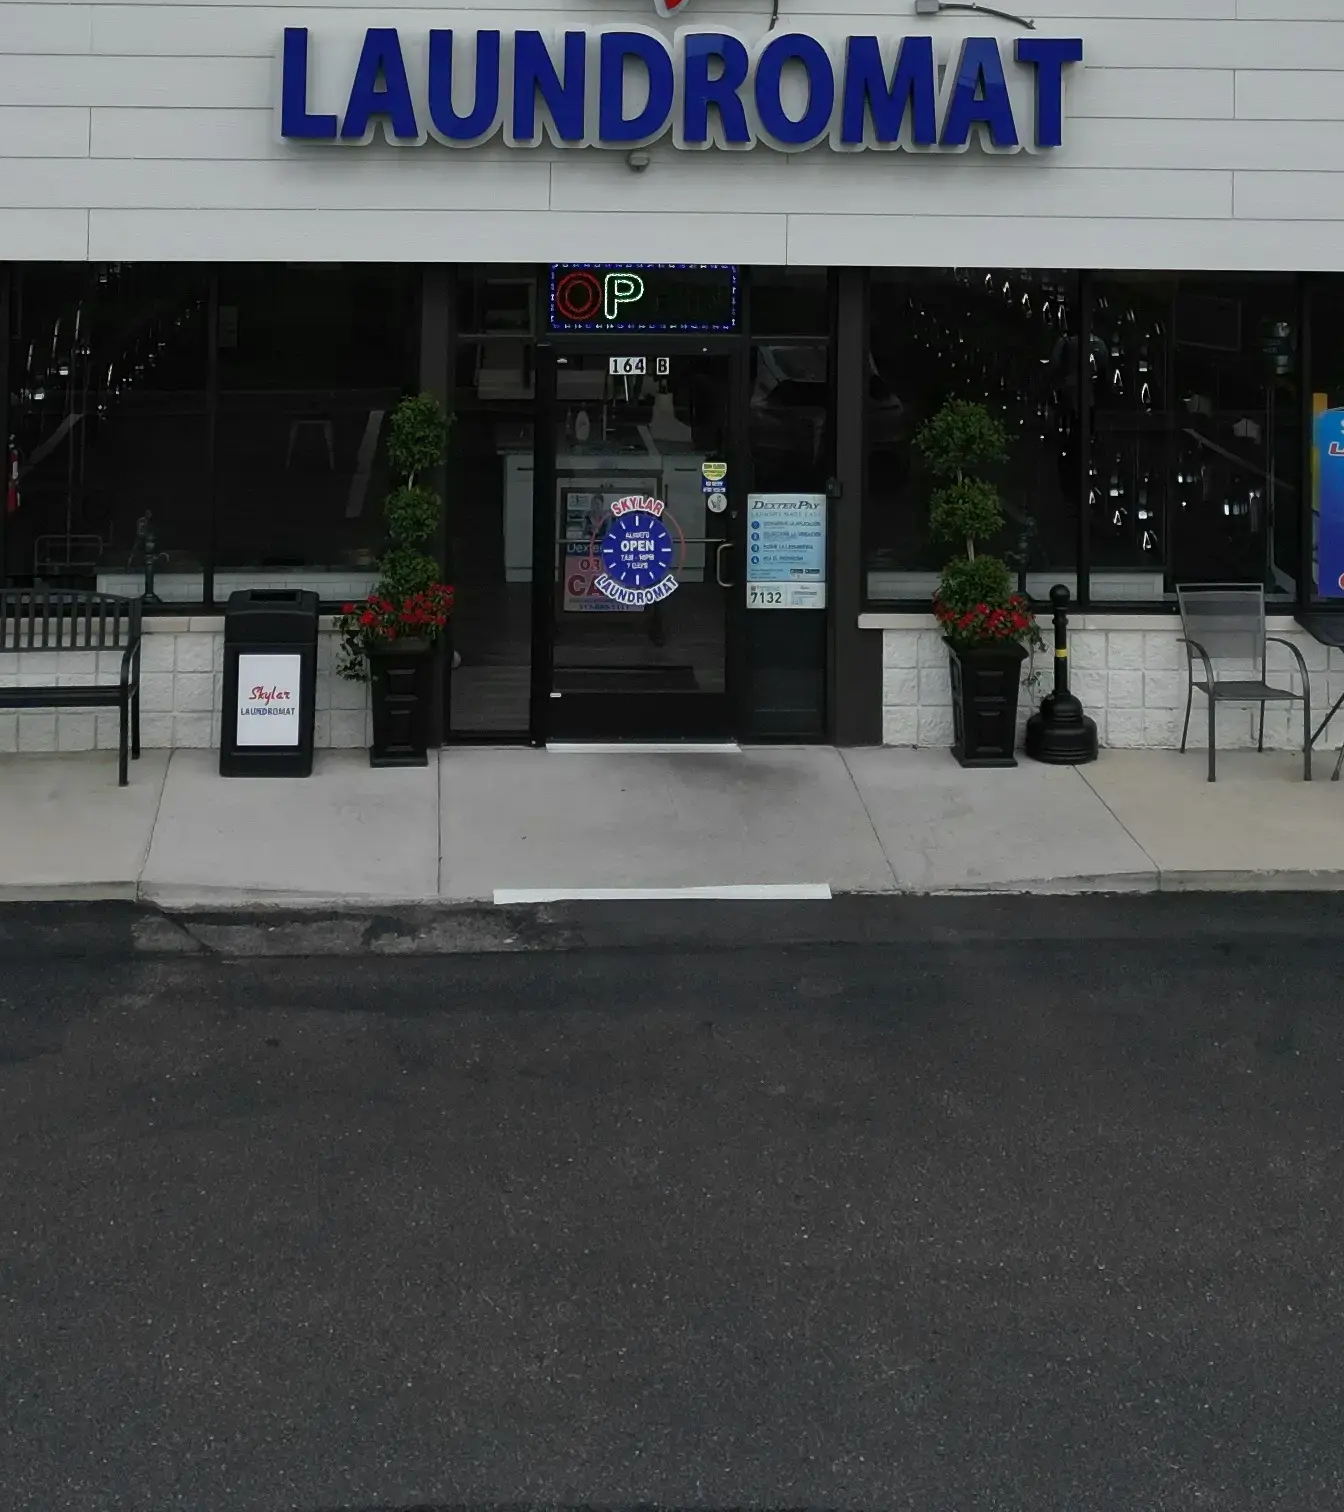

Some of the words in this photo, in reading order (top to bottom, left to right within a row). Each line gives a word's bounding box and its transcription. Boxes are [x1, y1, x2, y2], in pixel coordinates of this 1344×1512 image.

[281, 26, 1084, 148] LAUNDROMAT
[612, 358, 646, 374] 164
[657, 358, 669, 374] B
[612, 496, 663, 516] SKYLAR
[621, 540, 655, 552] OPEN
[596, 575, 678, 604] LAUNDROMAT
[750, 592, 782, 604] 7132
[248, 685, 291, 706] Skylar
[240, 707, 296, 716] LAUNDROMAT
